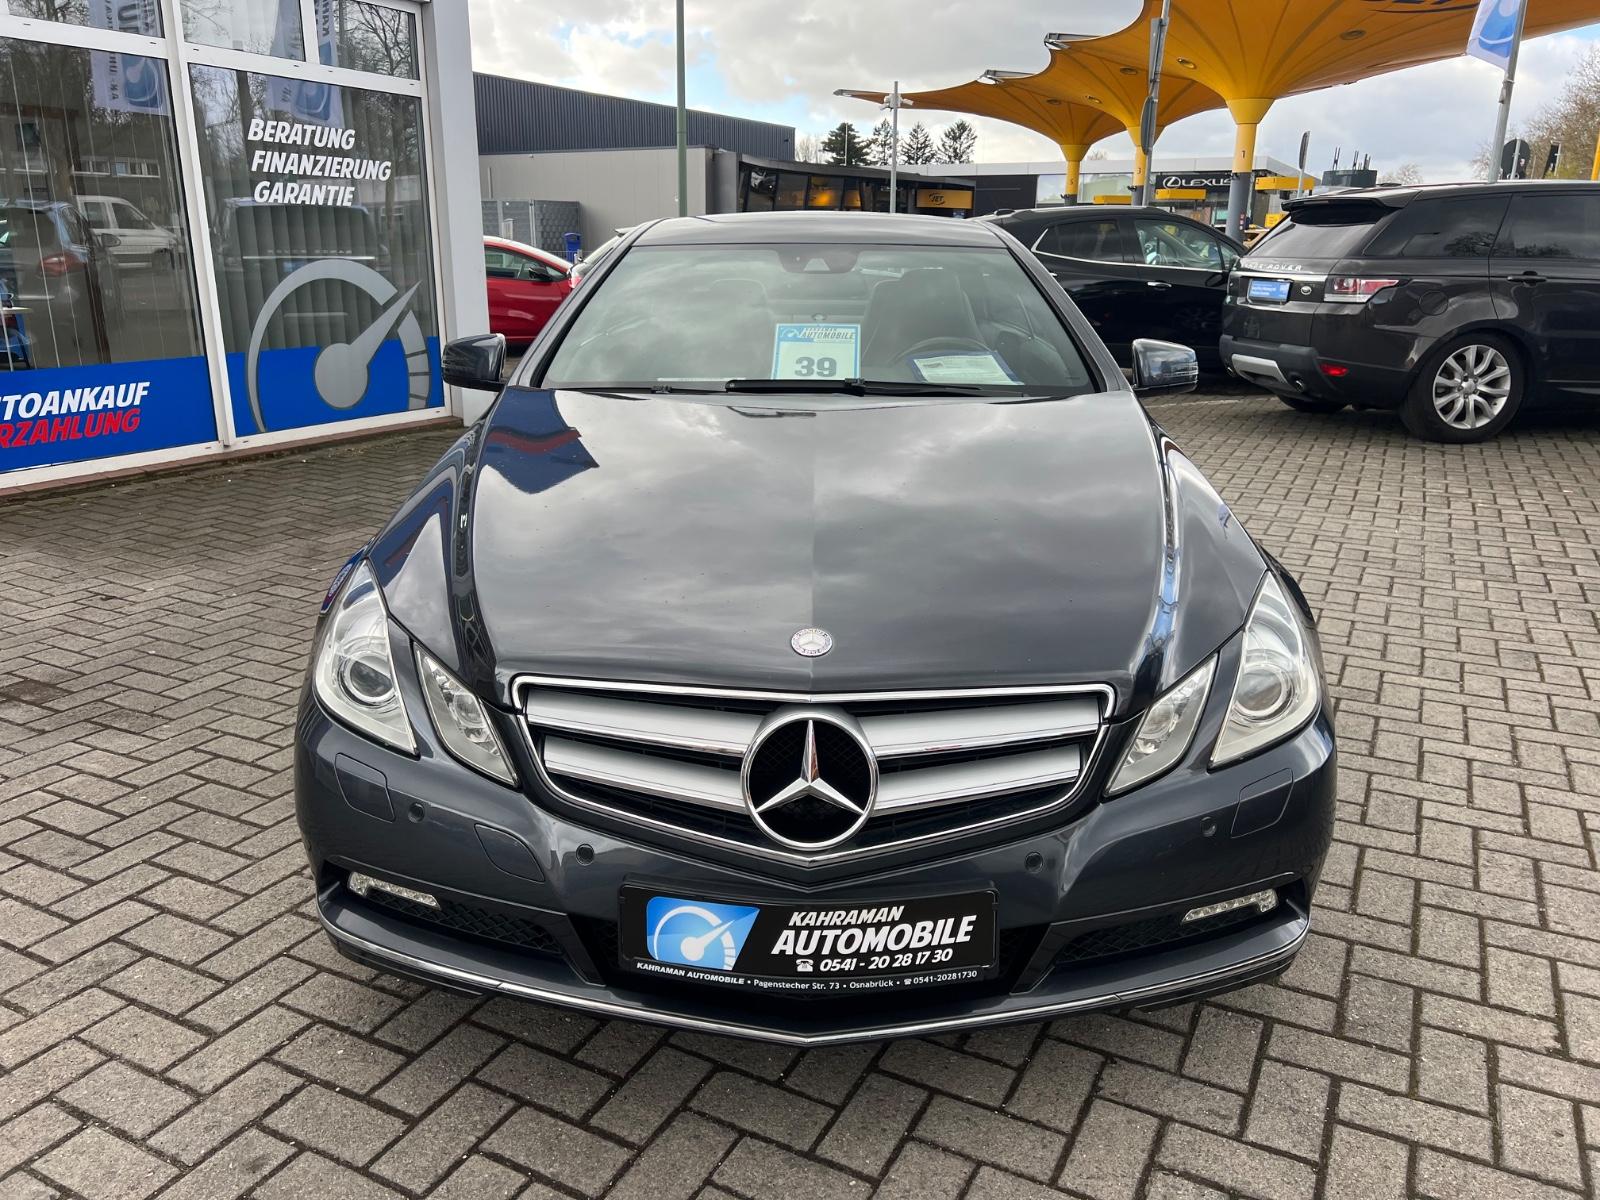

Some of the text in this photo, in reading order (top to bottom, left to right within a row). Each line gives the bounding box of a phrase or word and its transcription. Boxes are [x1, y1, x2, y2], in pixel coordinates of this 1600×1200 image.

[247, 118, 356, 150] BERATUNG
[251, 150, 392, 181] FINANZIERUNG
[254, 181, 355, 207] GARANTIE
[1267, 263, 1302, 271] ROVER
[800, 330, 857, 340] AUTOMOBILE
[794, 356, 837, 377] 39
[0, 381, 150, 421] TOANKAUF
[788, 905, 905, 926] KAHRAMAN
[771, 915, 977, 955] AUTOMOBILE
[819, 958, 857, 972] 0541
[868, 956, 890, 970] 20
[892, 953, 912, 968] 28
[915, 950, 932, 965] 17
[932, 948, 953, 963] 30
[636, 962, 978, 990] KAHRAMAN AUTOMOBILE Pagenstecher Str. 73 Osnabrück 0541-20281730
